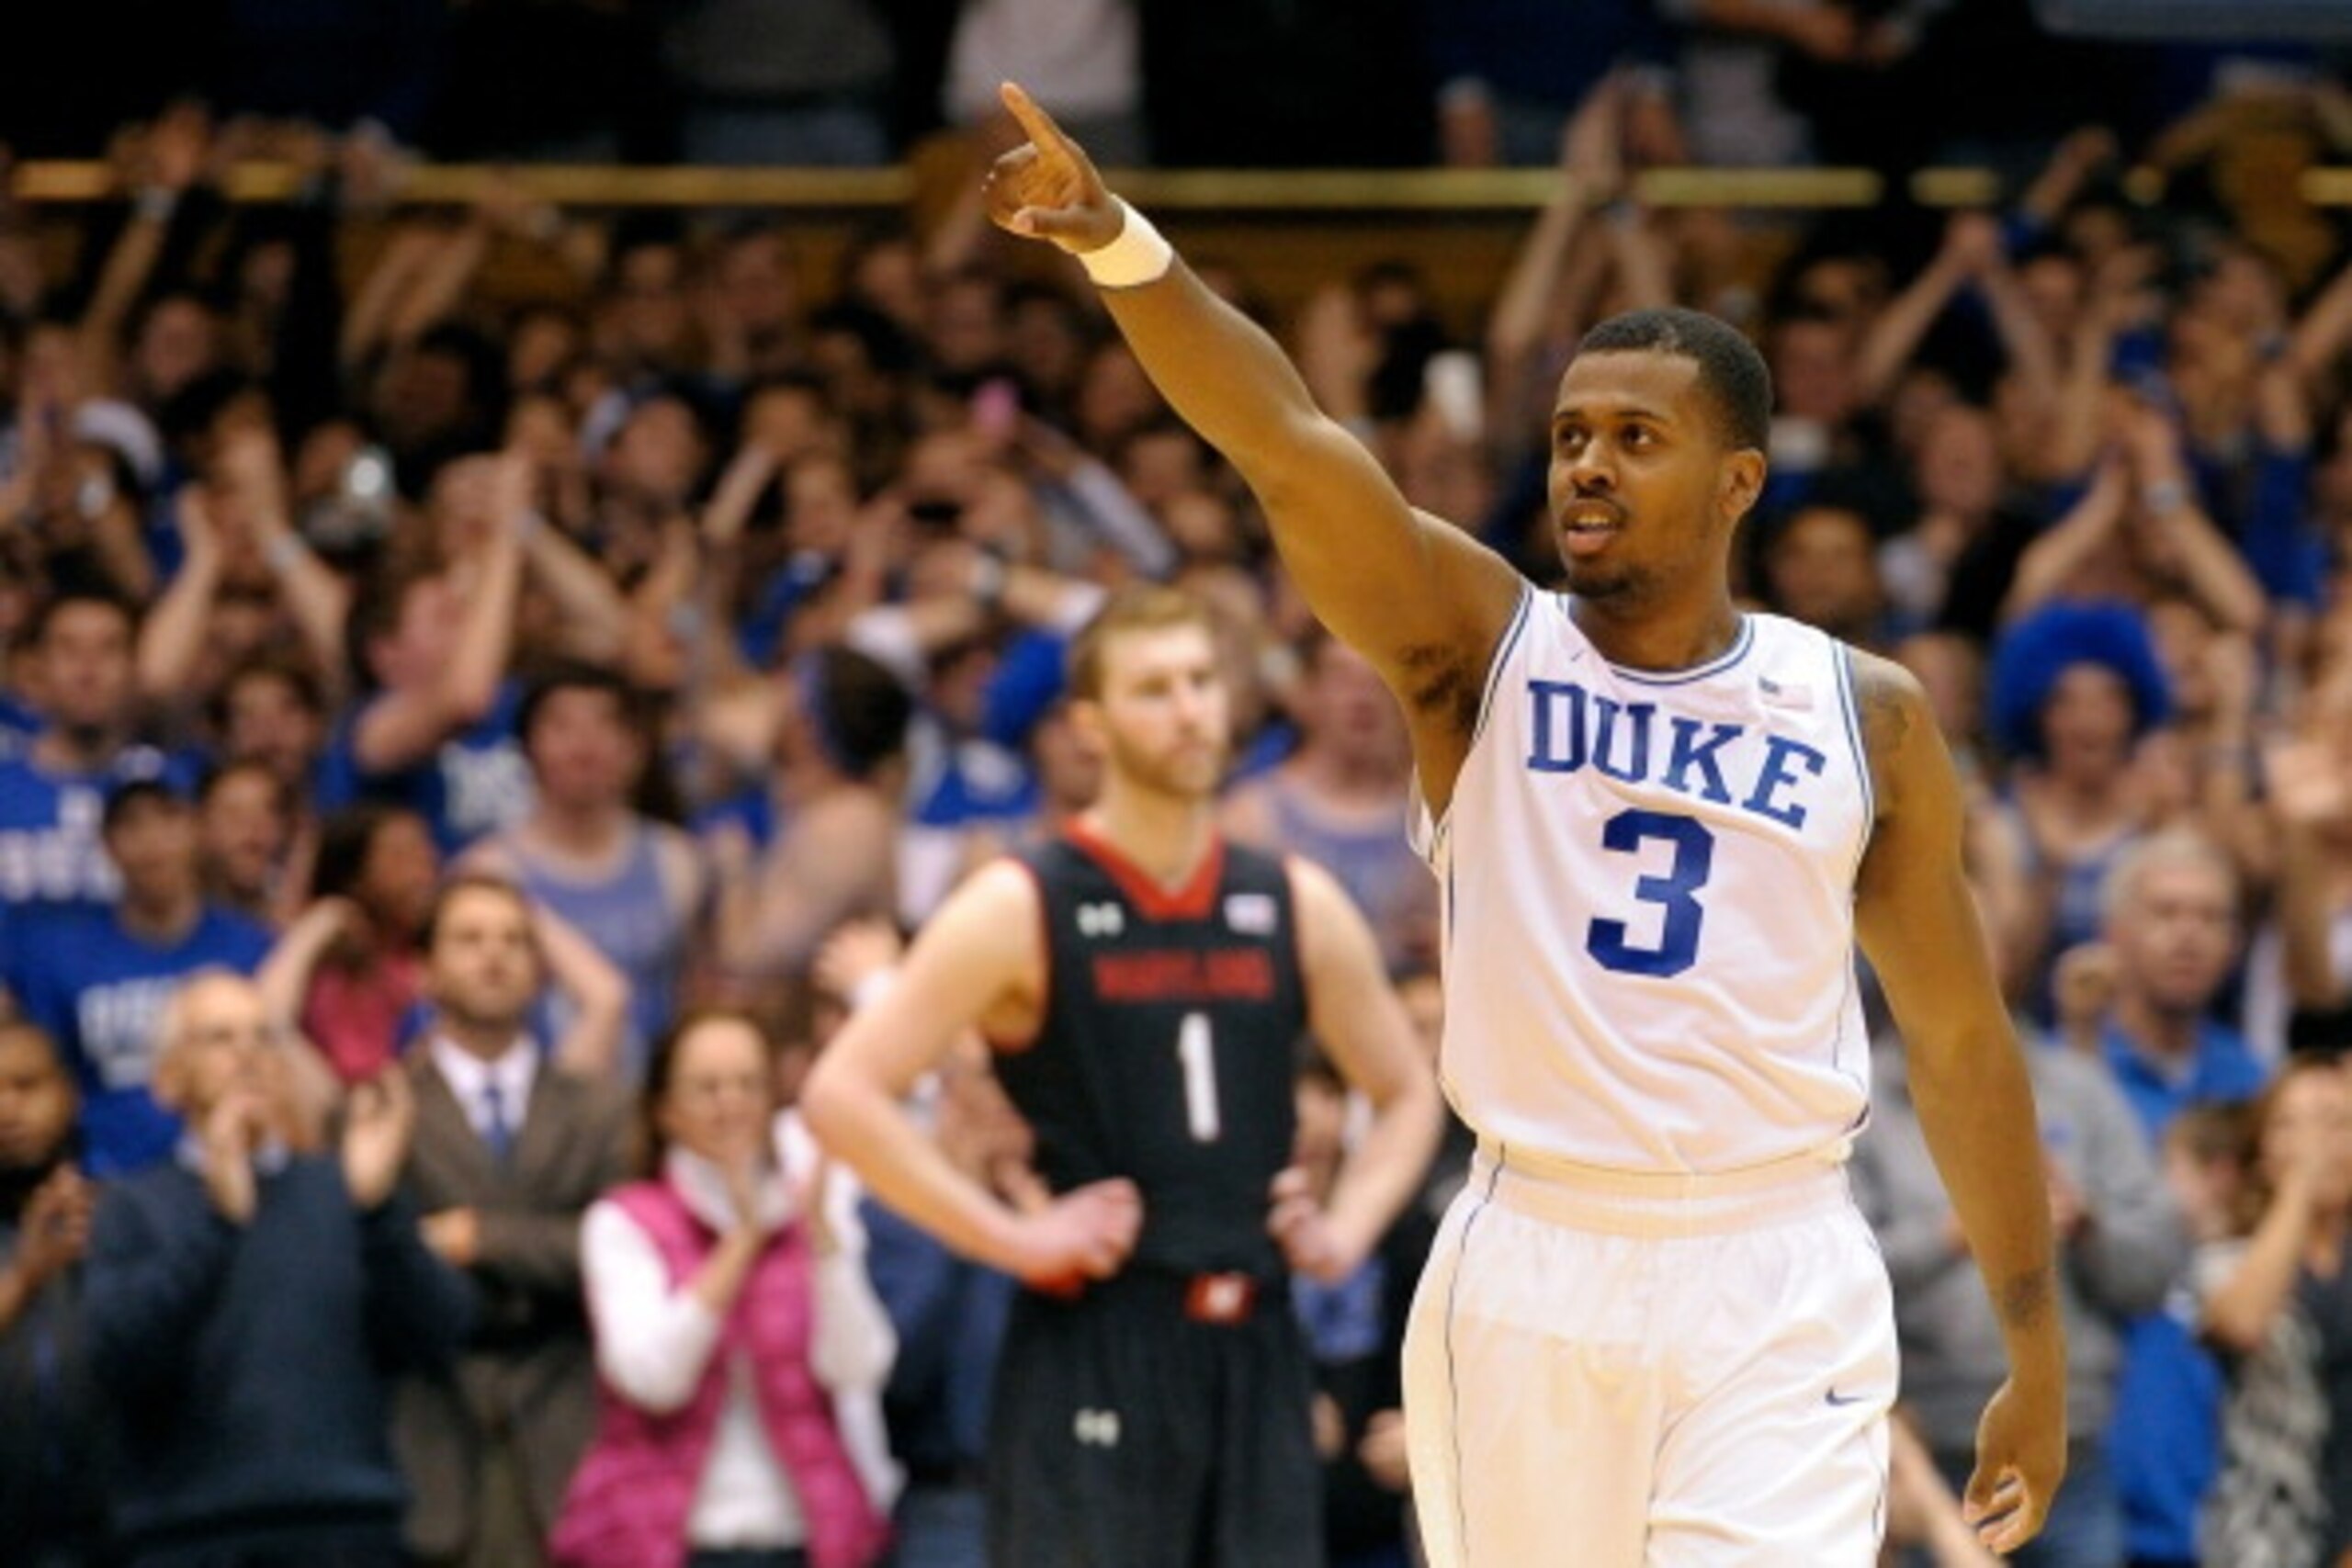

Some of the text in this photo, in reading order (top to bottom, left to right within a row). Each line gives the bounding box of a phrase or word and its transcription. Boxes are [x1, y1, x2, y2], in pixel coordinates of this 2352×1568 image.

[1527, 679, 1826, 830] DUKE
[1587, 809, 1714, 978] 3
[1178, 1011, 1221, 1143] 1
